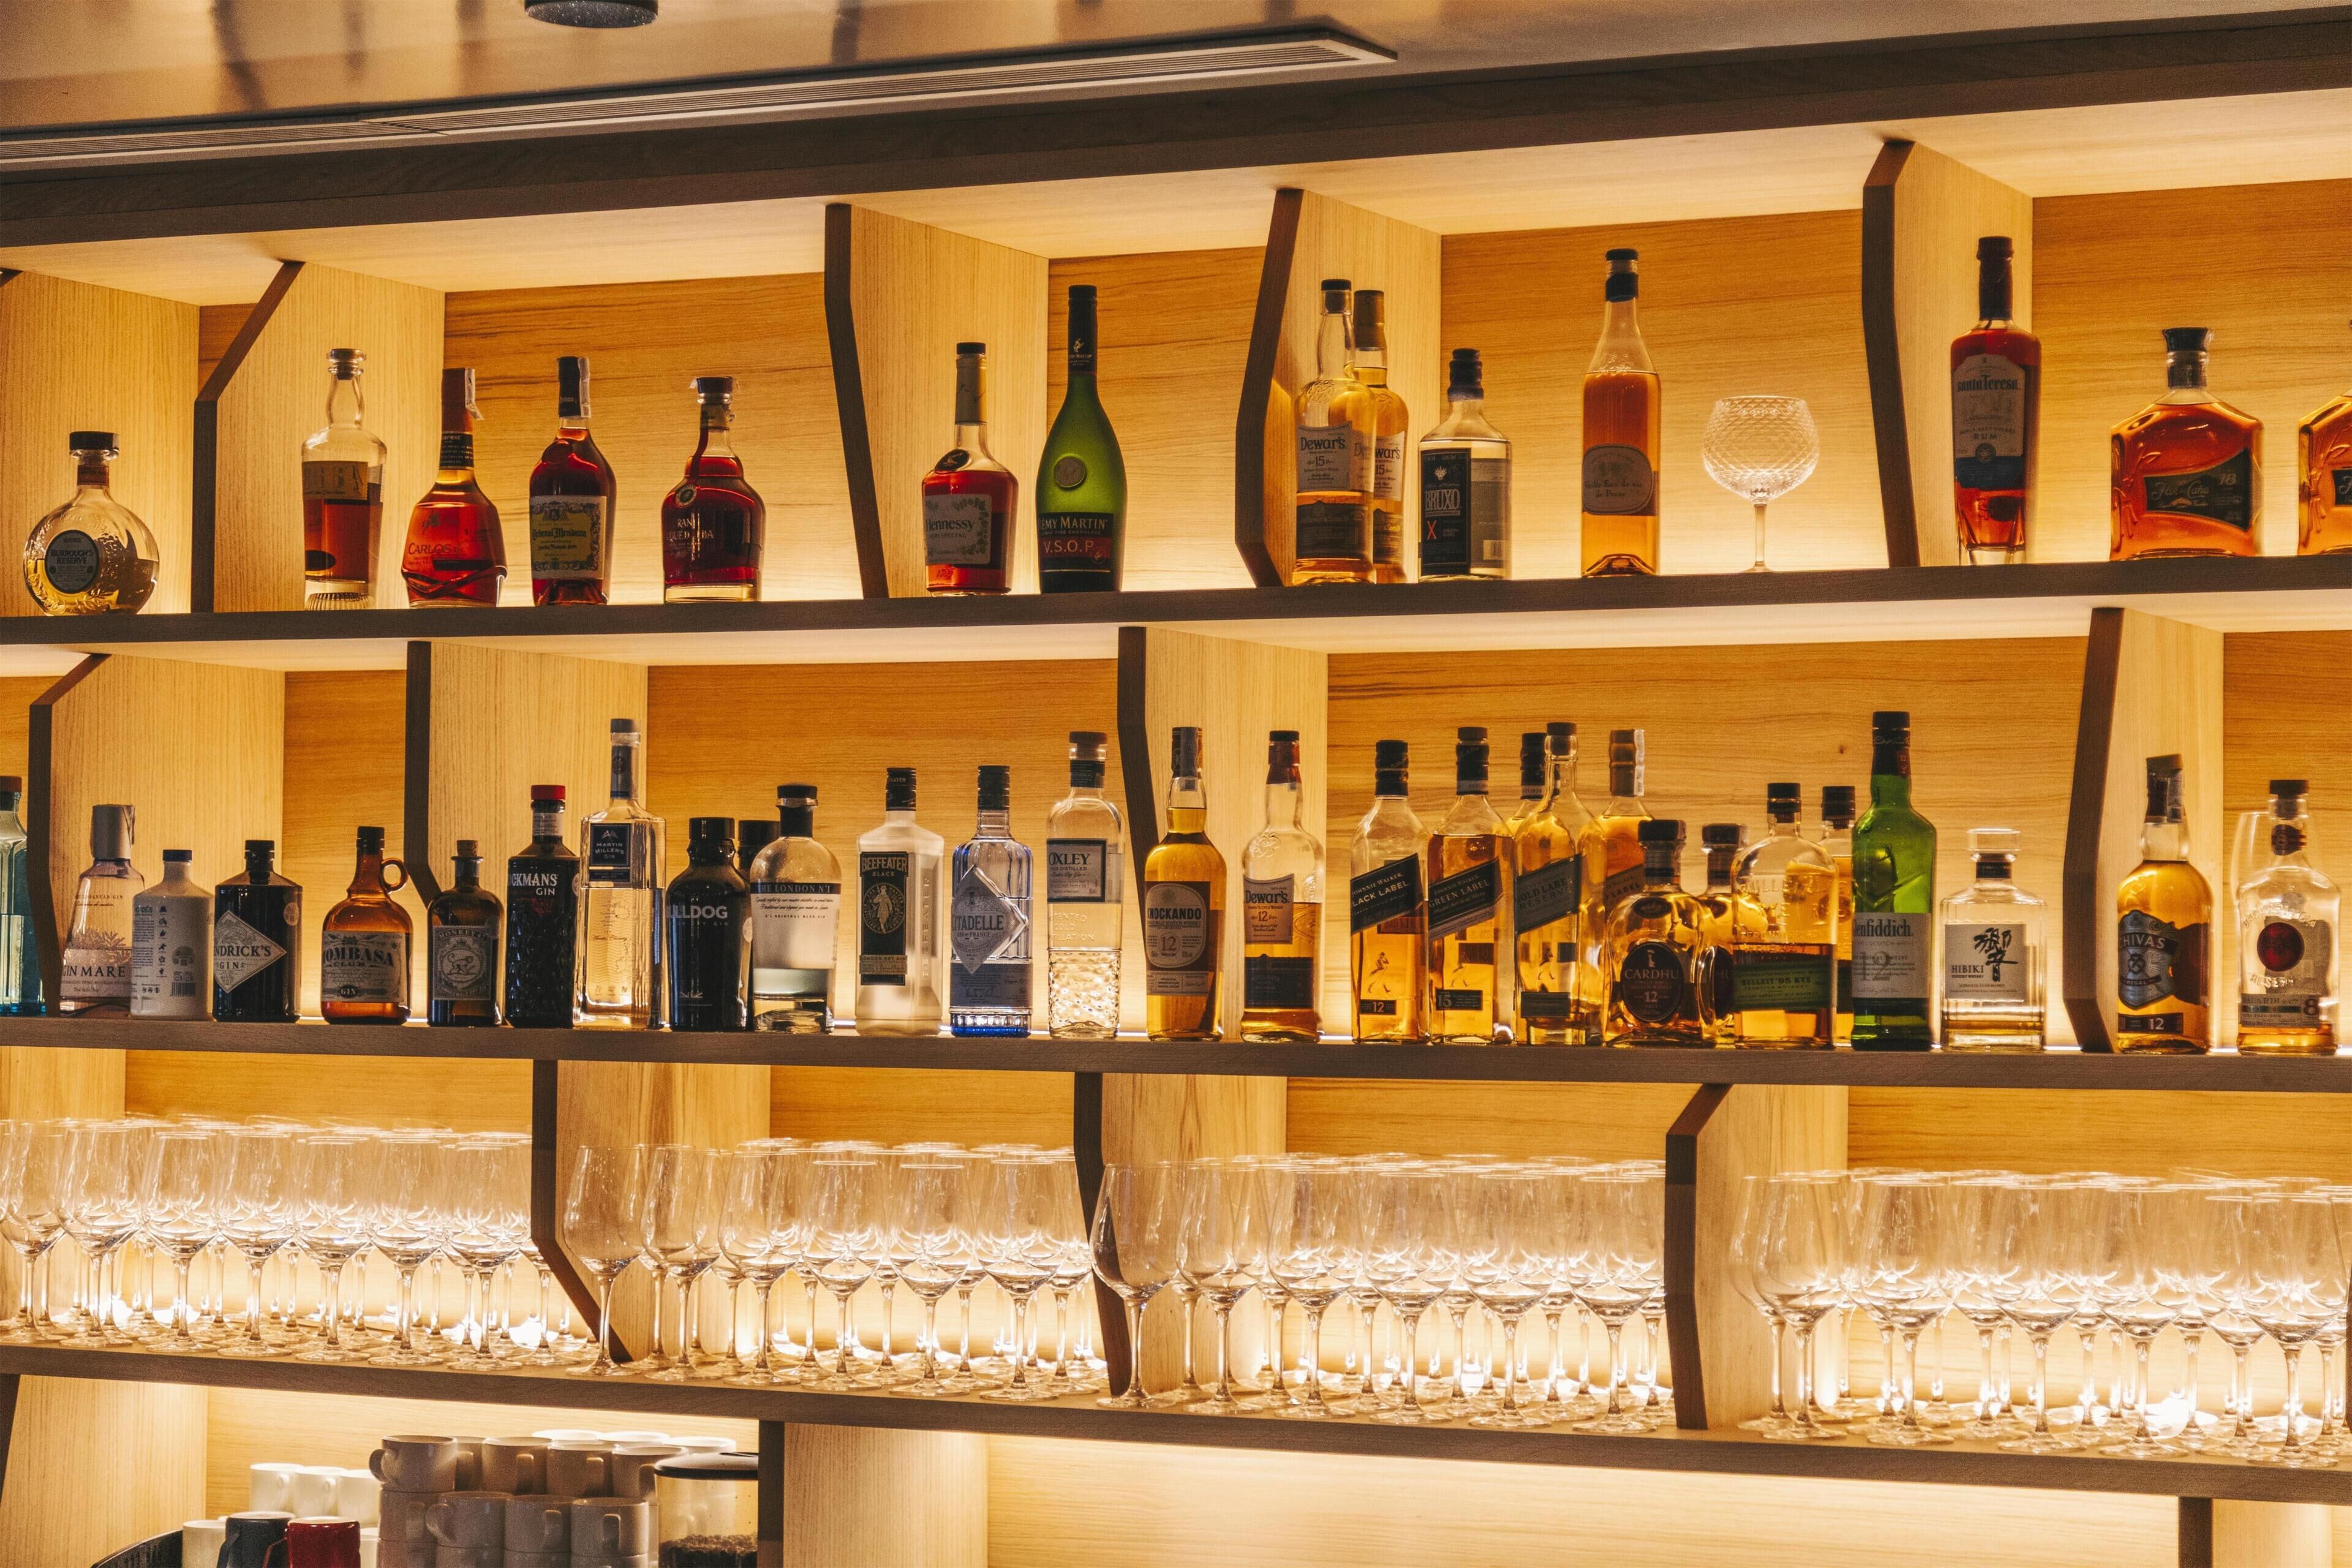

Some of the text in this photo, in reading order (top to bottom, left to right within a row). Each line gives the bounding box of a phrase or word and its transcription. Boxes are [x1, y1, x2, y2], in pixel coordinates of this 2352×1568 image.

[1300, 437, 1346, 450] Dewar's
[1315, 456, 1325, 467] 15
[1376, 464, 1385, 475] 15
[2219, 473, 2237, 486] 18
[1425, 489, 1460, 510] BRUXO
[925, 518, 975, 532] Hennessy
[1061, 516, 1105, 529] MARTIN
[1427, 520, 1437, 540] X
[408, 542, 452, 554] CARLOS
[862, 857, 907, 872] BEEFEATER
[1049, 852, 1090, 865] OXLEY
[1378, 881, 1409, 896] LABEL
[1540, 878, 1570, 894] LABE
[1245, 890, 1288, 903] Dewar's
[1428, 892, 1459, 908] GREEN
[1460, 879, 1490, 895] LABEL
[1257, 911, 1268, 921] 12
[439, 929, 475, 938] MONKEY
[1160, 935, 1177, 951] 12
[1974, 927, 2019, 982] 響
[80, 965, 126, 978] MARE
[1624, 970, 1679, 979] CARDHU
[1951, 965, 1984, 973] HIBIKI
[1438, 995, 1452, 1007] 15
[1644, 991, 1658, 1002] 12
[1373, 1001, 1385, 1012] 12
[2303, 998, 2320, 1016] 8
[2148, 1017, 2165, 1030] 12
